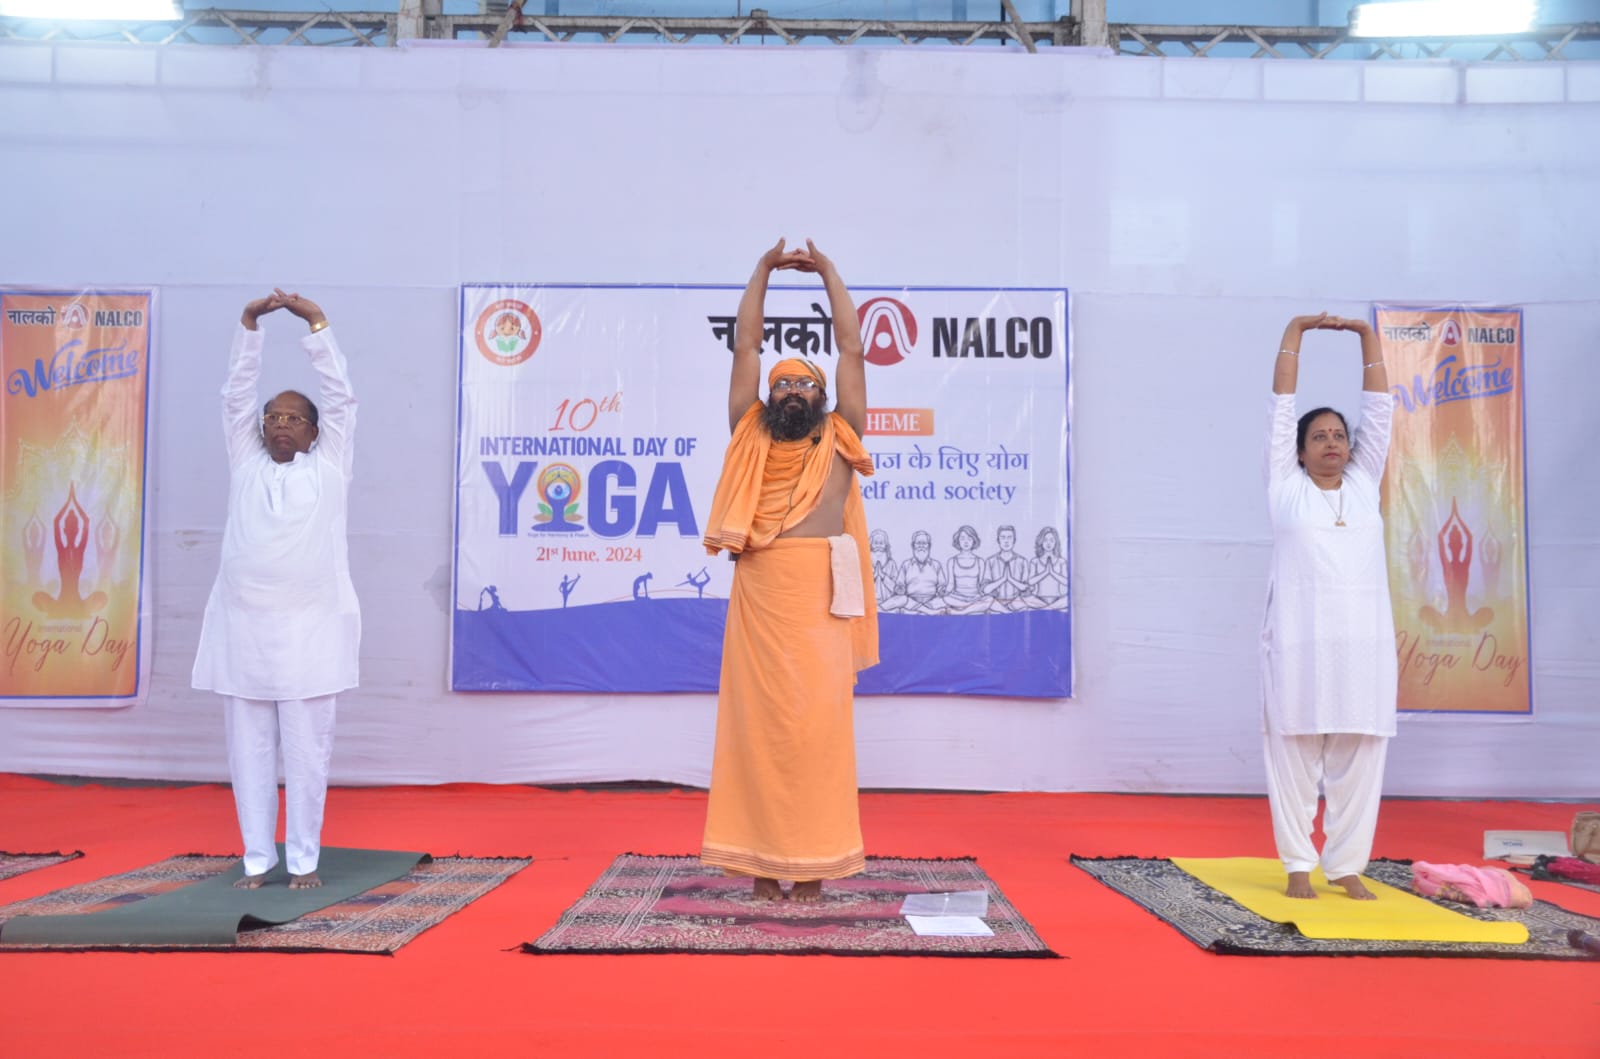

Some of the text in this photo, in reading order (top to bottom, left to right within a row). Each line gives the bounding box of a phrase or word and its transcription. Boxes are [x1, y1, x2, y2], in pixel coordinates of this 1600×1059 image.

[7, 306, 56, 325] नालको
[95, 310, 143, 327] NALCO
[707, 302, 832, 357] नलको
[932, 316, 1053, 359] NALCO
[1383, 321, 1432, 342] नालको
[1468, 327, 1515, 344] NALCO
[7, 338, 140, 398] Welcome
[1389, 354, 1514, 413] Welcome
[548, 391, 623, 432] 10th
[867, 413, 920, 432] HEME
[480, 436, 697, 456] INTERNATIONAL DAY OF
[908, 444, 932, 469] के
[938, 445, 981, 477] लिए
[986, 444, 1030, 470] योग
[860, 480, 1016, 505] elf and society
[605, 546, 642, 562] 2024
[4, 615, 136, 677] Yoga Day
[1396, 630, 1526, 687] Yoga Day
